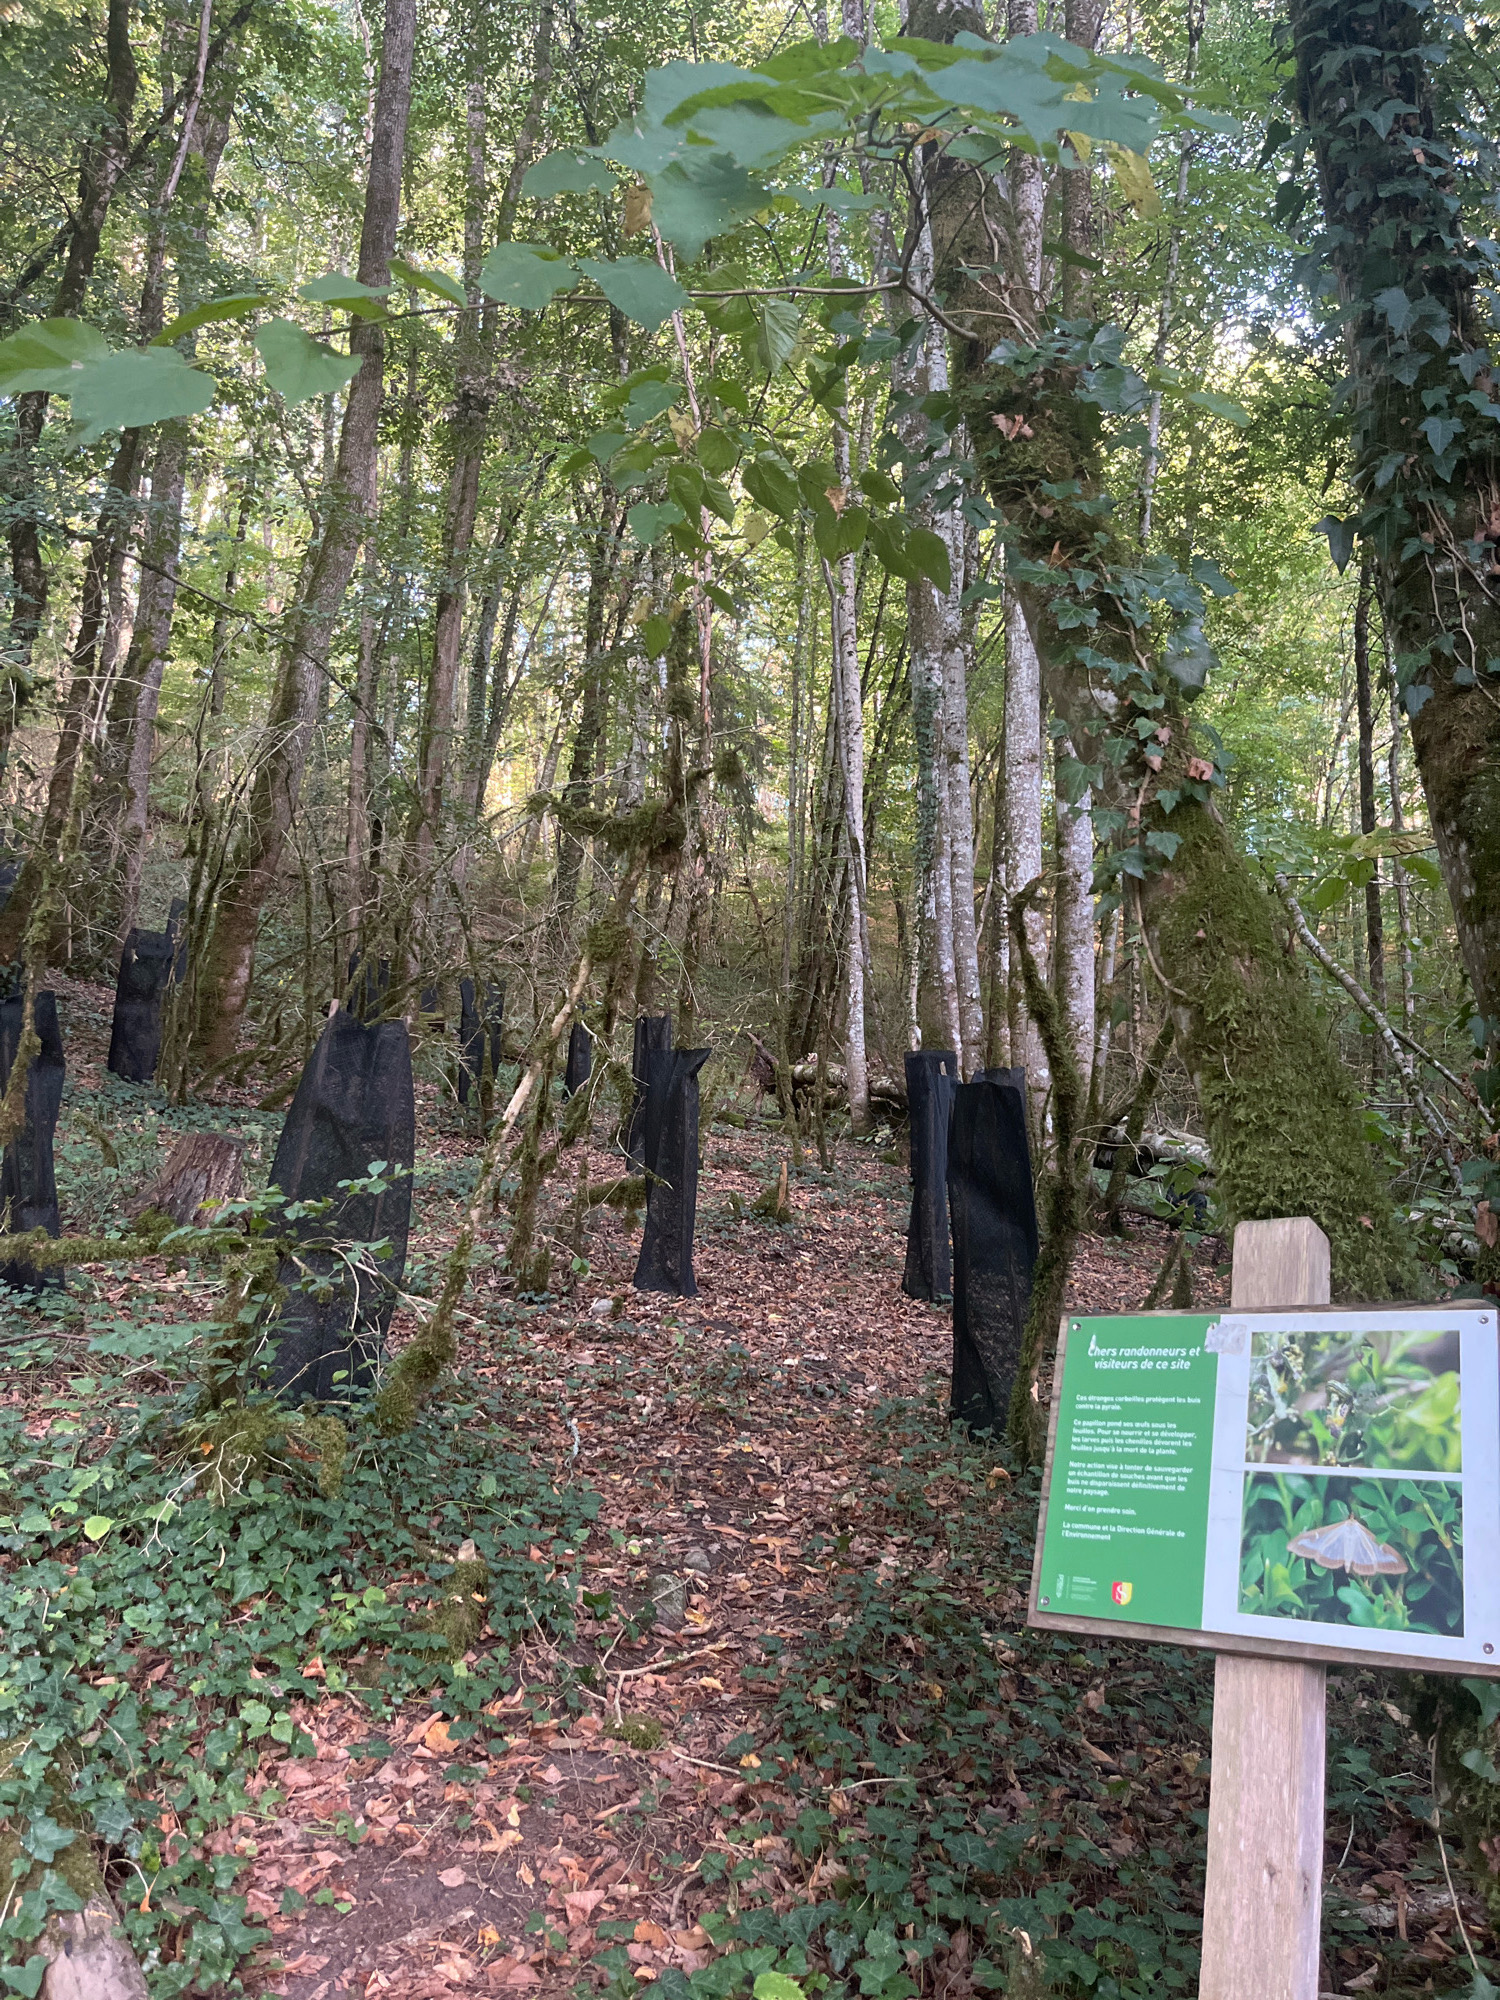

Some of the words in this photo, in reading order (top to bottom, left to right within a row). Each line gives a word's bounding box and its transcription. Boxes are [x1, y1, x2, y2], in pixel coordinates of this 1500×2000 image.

[1088, 1346, 1117, 1356] Chers
[1119, 1346, 1186, 1356] randonneurs
[1189, 1346, 1201, 1356] et
[1095, 1359, 1138, 1369] visiteurs
[1141, 1359, 1153, 1369] de
[1156, 1361, 1169, 1370] ce
[1171, 1360, 1190, 1370] site
[1088, 1395, 1114, 1403] étranges
[1146, 1396, 1175, 1404] protègent
[1083, 1419, 1106, 1427] papillon
[1107, 1420, 1122, 1428] pond
[1101, 1437, 1113, 1445] puis
[1154, 1438, 1181, 1446] dévorent
[1154, 1465, 1193, 1474] sauvegarder
[1090, 1480, 1130, 1489] disparaissent
[1131, 1482, 1176, 1490] définitivement
[1083, 1489, 1109, 1497] paysage.
[1065, 1504, 1081, 1512] Merci
[1096, 1506, 1121, 1515] prendre
[1122, 1507, 1136, 1515] soin.
[1063, 1521, 1070, 1529] La
[1072, 1524, 1101, 1532] commune
[1102, 1524, 1108, 1532] et
[1110, 1525, 1116, 1533] la
[1117, 1525, 1145, 1535] Direction
[1146, 1527, 1176, 1537] Générale
